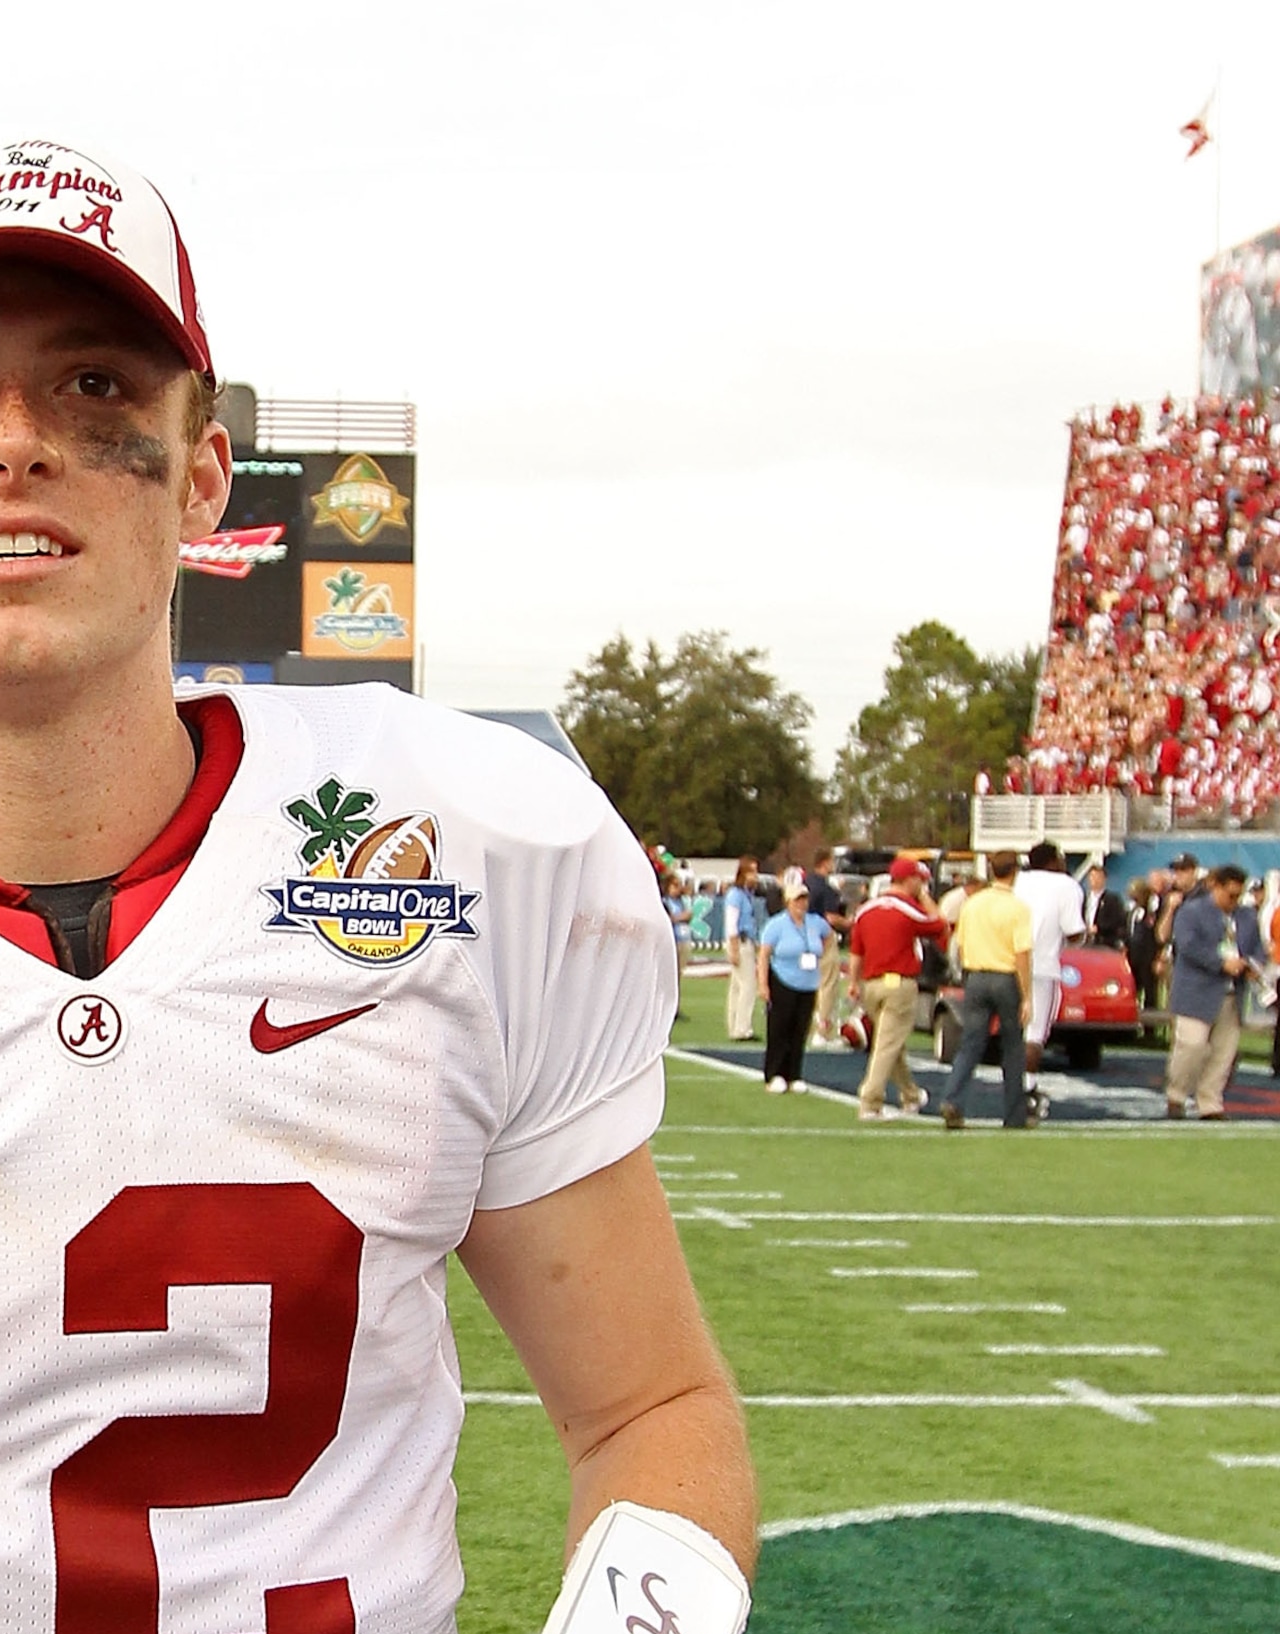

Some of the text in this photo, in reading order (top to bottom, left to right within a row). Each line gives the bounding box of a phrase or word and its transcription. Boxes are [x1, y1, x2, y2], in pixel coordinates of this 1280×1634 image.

[5, 150, 53, 169] Bowl
[59, 195, 120, 253] A
[346, 918, 400, 935] BOWL
[347, 943, 401, 958] ORLANDO
[69, 1002, 109, 1046] A
